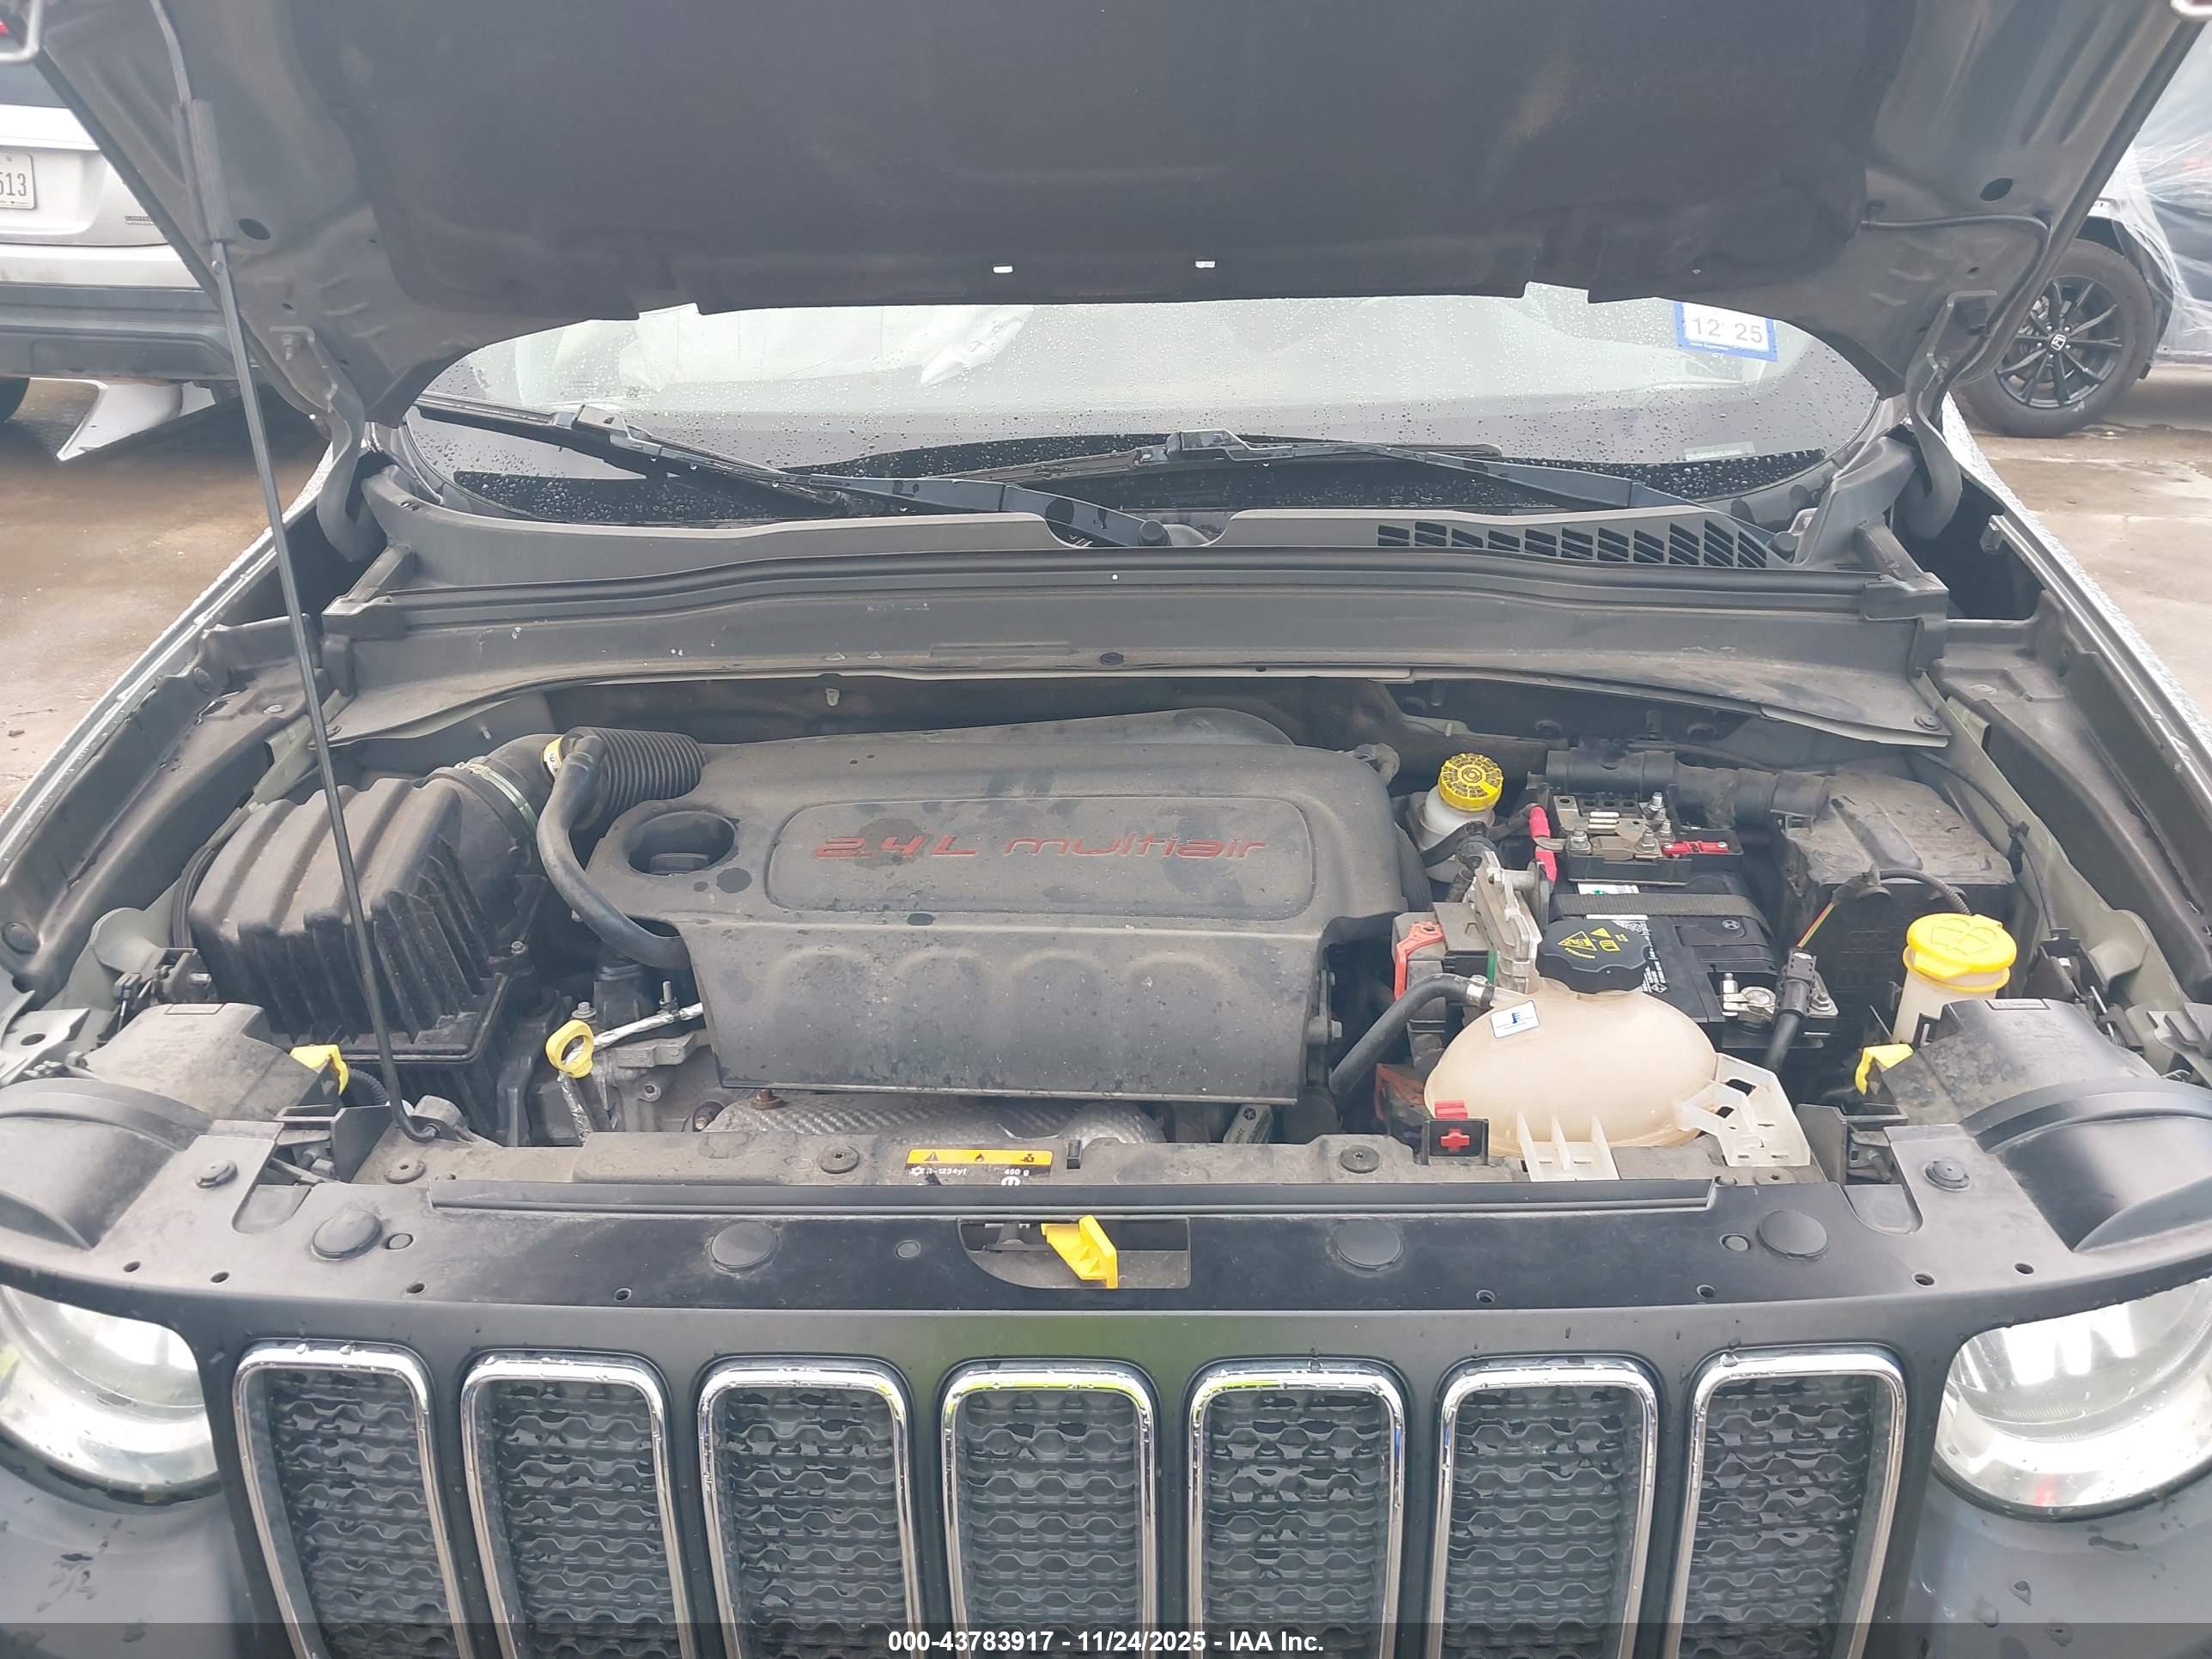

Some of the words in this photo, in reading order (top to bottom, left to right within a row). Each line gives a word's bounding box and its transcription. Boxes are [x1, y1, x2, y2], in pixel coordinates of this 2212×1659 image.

[1692, 317, 1721, 337] 12
[1735, 322, 1763, 343] 25
[813, 836, 980, 859] 2.4L
[1003, 831, 1267, 860] multiair
